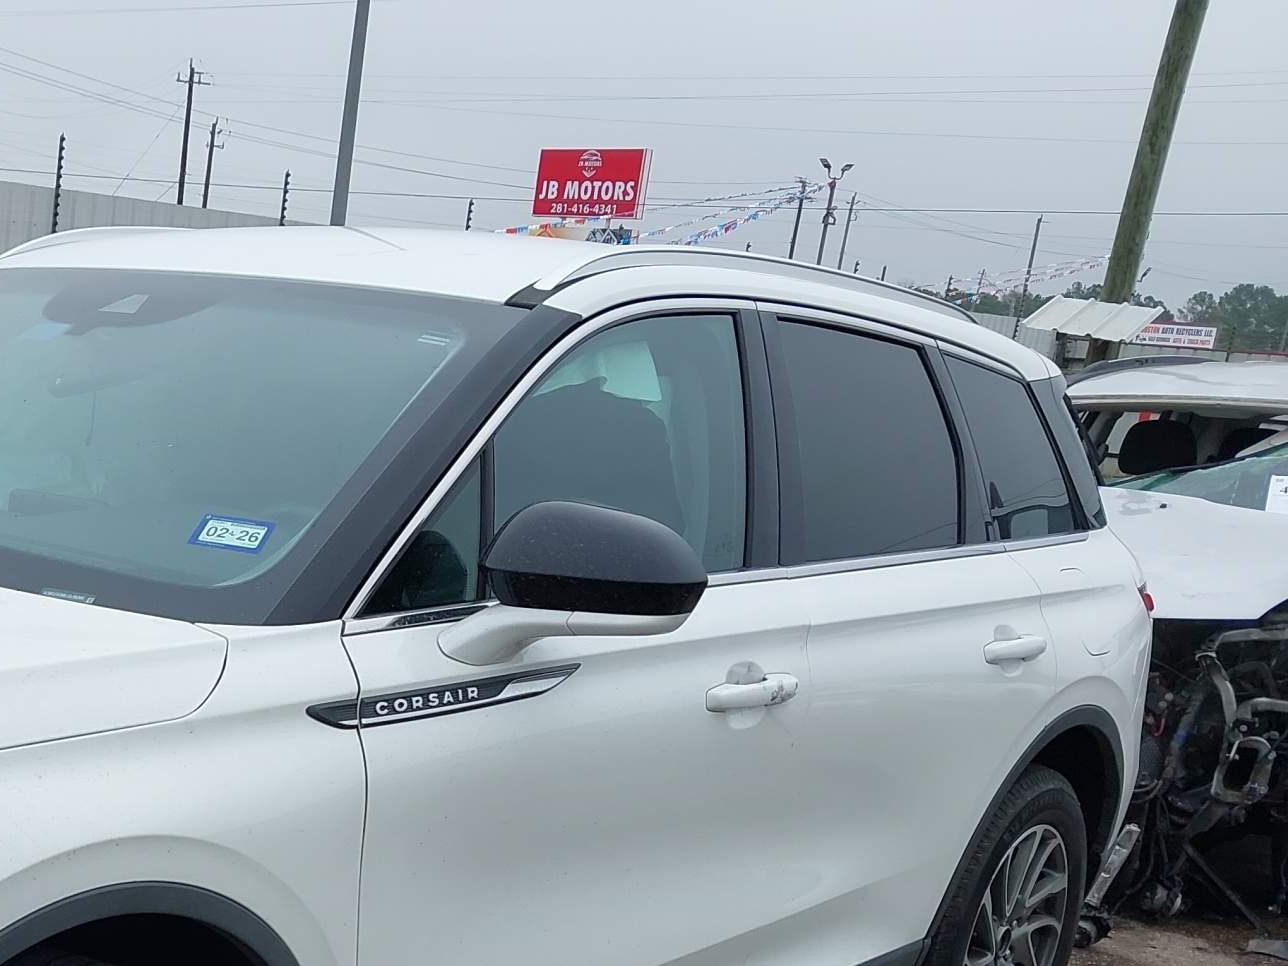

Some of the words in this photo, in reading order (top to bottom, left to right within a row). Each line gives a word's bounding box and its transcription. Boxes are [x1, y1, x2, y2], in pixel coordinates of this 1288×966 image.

[539, 180, 558, 200] JB
[565, 181, 634, 201] MOTORS
[550, 203, 617, 214] 281-416-4341
[206, 526, 229, 538] 02
[236, 530, 261, 543] 26
[375, 687, 479, 715] CORSAIR
